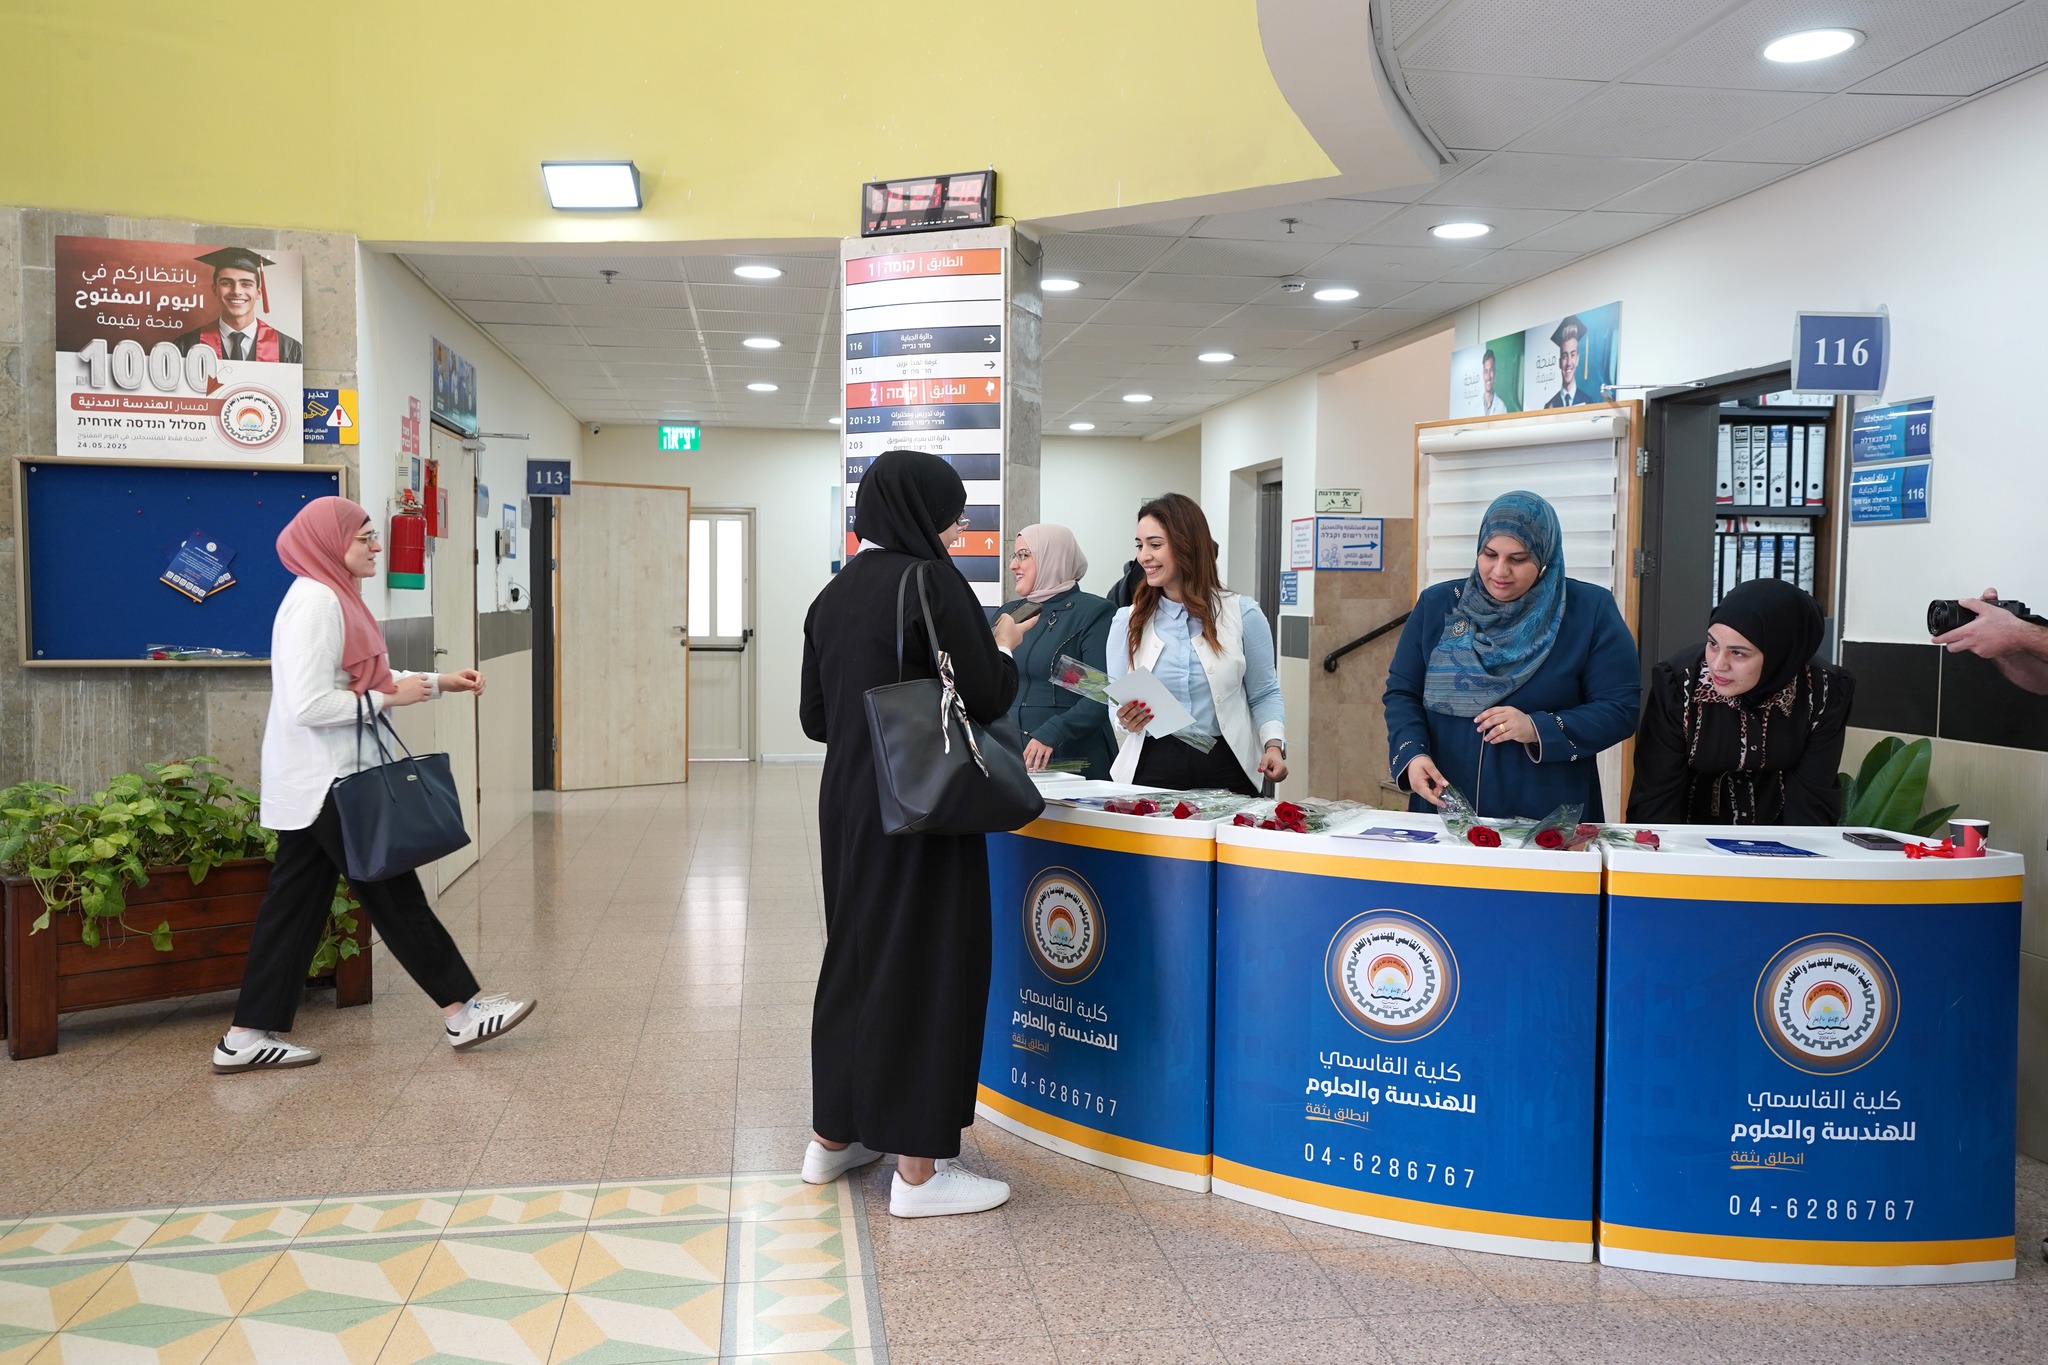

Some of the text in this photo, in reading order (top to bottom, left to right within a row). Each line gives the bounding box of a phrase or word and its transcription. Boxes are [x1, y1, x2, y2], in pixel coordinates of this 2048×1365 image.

[82, 263, 197, 287] بانتظاركم في
[868, 256, 963, 276] الطابق קומה 1
[74, 288, 204, 312] اليوم المفتوح
[96, 312, 183, 330] منحة بقيمة
[850, 342, 862, 351] 116
[1813, 337, 1870, 366] 116
[78, 338, 218, 393] 1000
[850, 367, 862, 375] 115
[1536, 353, 1556, 369] منحة
[308, 391, 329, 399] تحذير
[870, 384, 966, 401] الطابق קמה 2
[78, 397, 208, 412] لمسار الهندسة المدنية
[78, 417, 206, 430] מסלול הנדסה אזרחית
[850, 416, 880, 424] 201-213
[1910, 424, 1927, 436] 116
[663, 428, 695, 449] יציאה
[536, 471, 563, 484] 113
[1907, 488, 1924, 500] 116
[1020, 987, 1108, 1023] كلية القاسمي
[1012, 1010, 1118, 1051] للهندسة والعلوم
[1012, 1032, 1049, 1053] انطلق بثقة
[1320, 1051, 1461, 1084] كلية القاسمي
[1011, 1067, 1117, 1117] 04-6286767
[1306, 1077, 1476, 1114] للهندسة والعلوم
[1747, 1089, 1901, 1115] كلية القاسمي
[1305, 1102, 1369, 1122] انطلق بثقة
[1730, 1119, 1916, 1144] للهندسة والعلوم
[1304, 1143, 1474, 1188] 04-6286767
[1730, 1150, 1804, 1166] انطلق بثقة
[1729, 1195, 1914, 1220] 04-6286767
